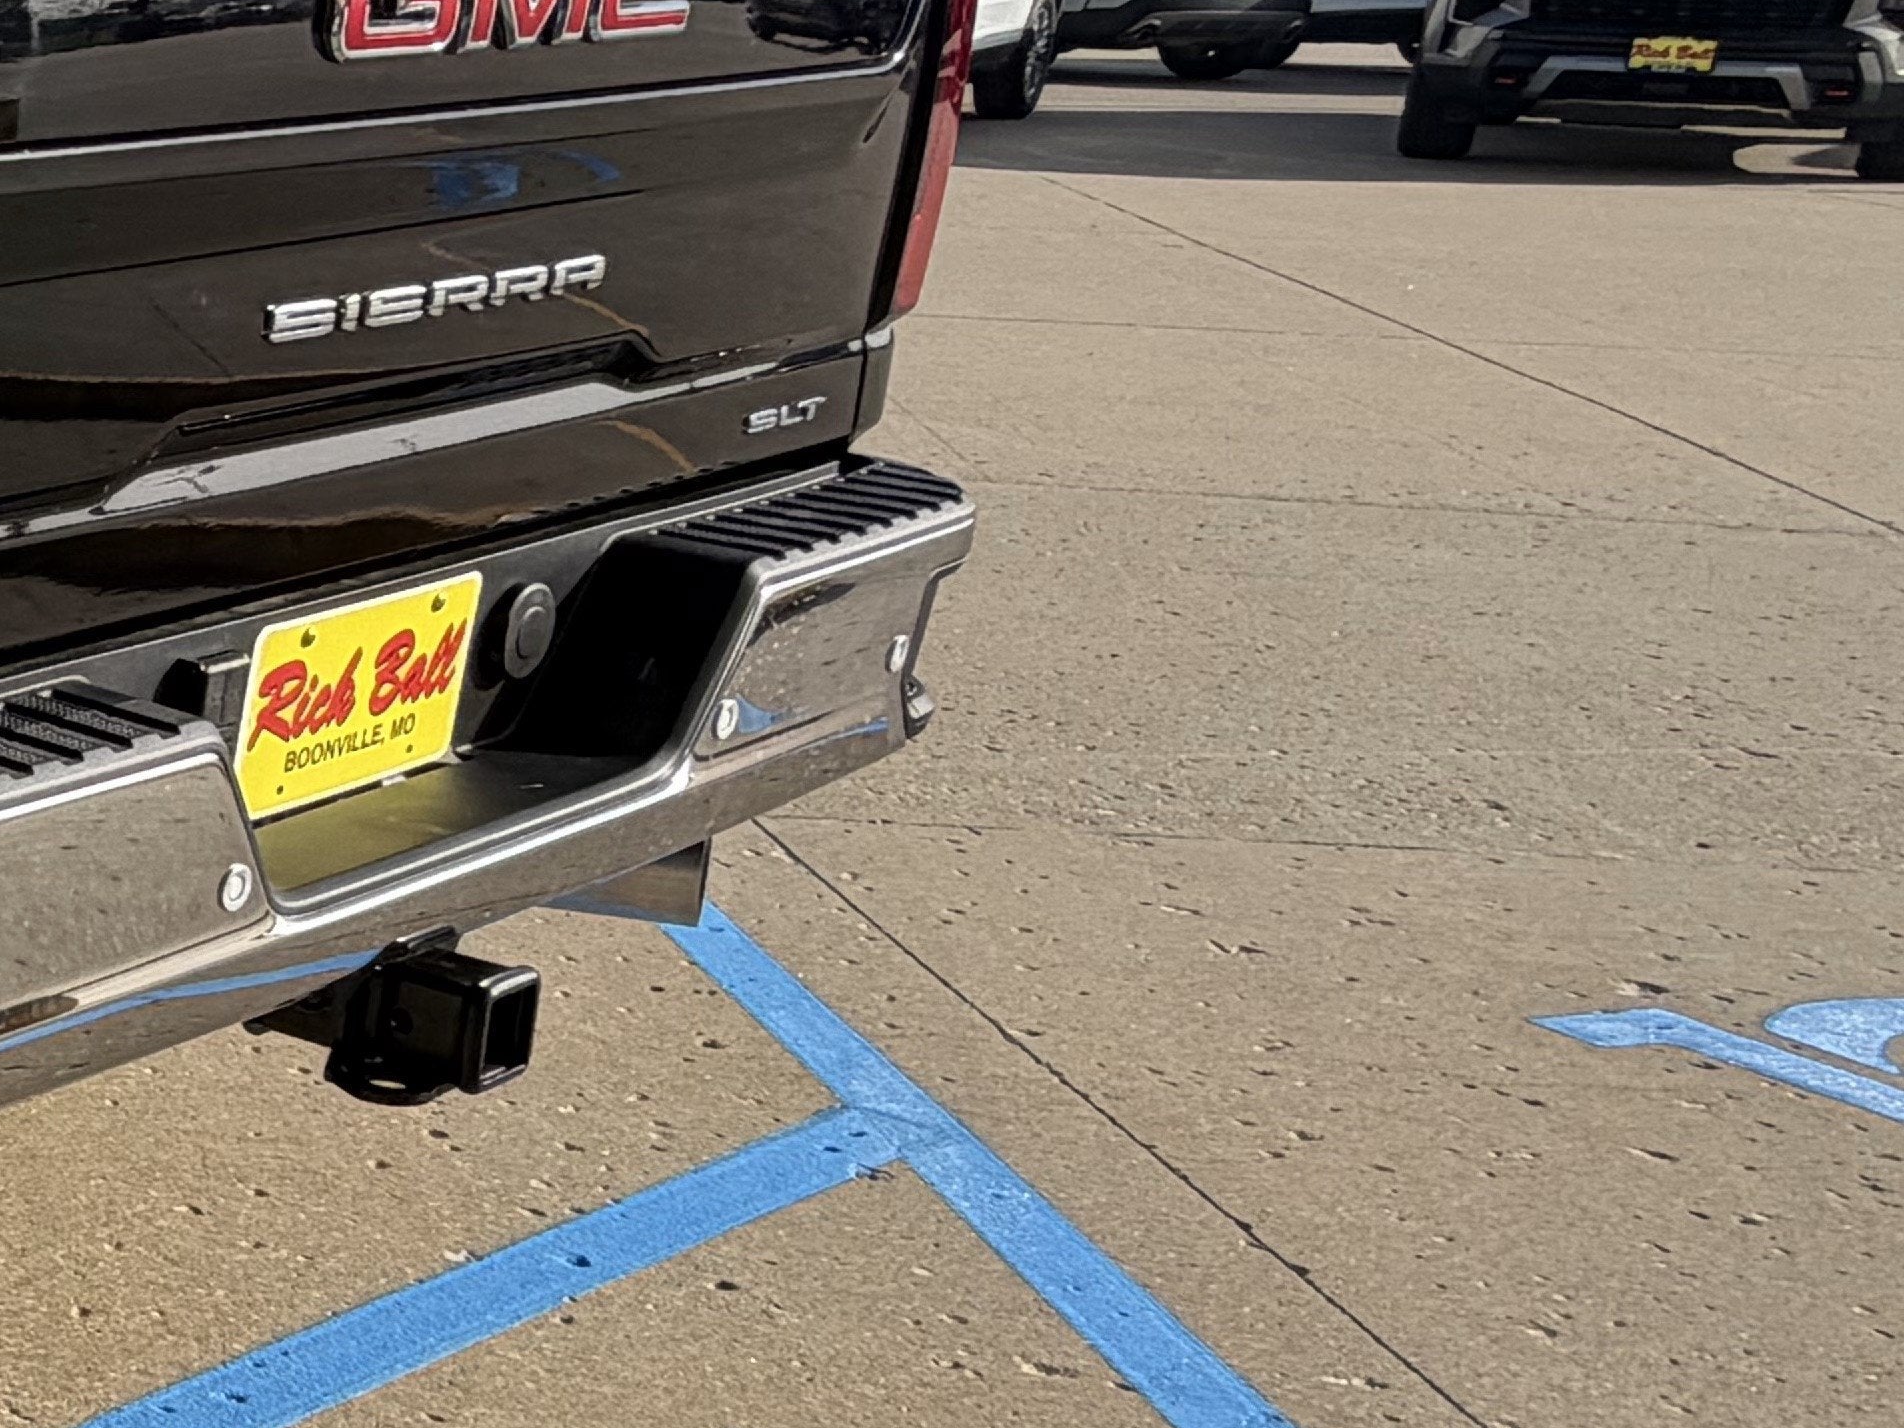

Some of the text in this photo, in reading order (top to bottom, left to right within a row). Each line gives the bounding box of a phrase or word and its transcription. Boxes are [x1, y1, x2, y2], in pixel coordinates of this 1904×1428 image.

[262, 254, 608, 344] SIERRA
[744, 395, 828, 434] SLT
[247, 617, 468, 753] Rick Ball
[284, 712, 417, 773] BOONVILLE, MO
